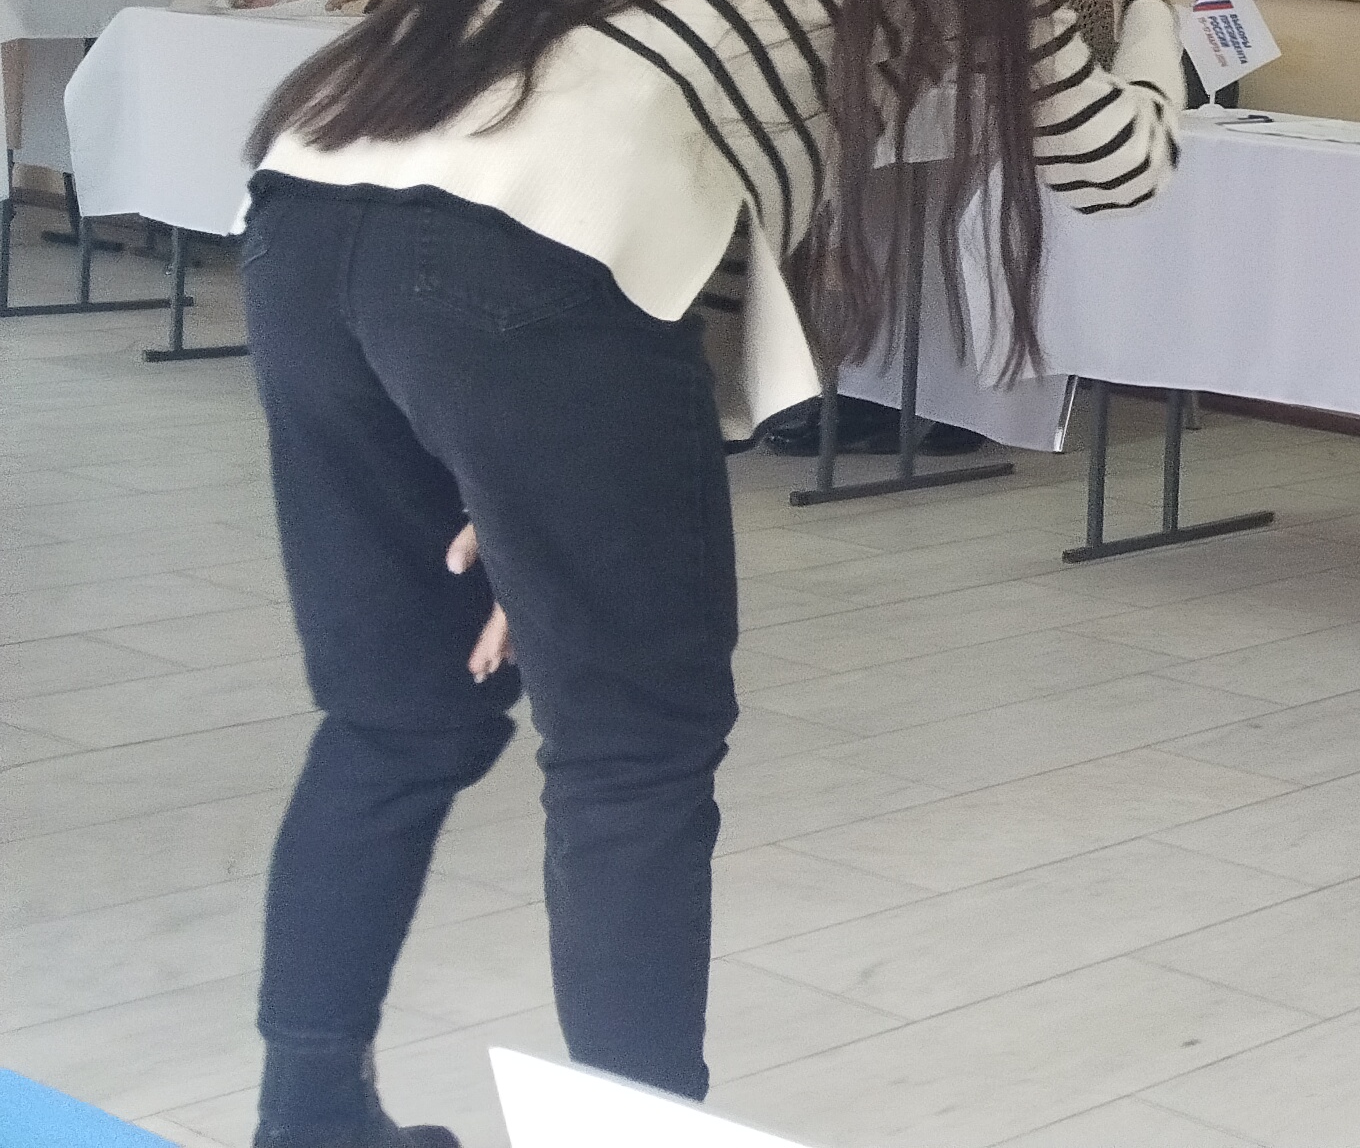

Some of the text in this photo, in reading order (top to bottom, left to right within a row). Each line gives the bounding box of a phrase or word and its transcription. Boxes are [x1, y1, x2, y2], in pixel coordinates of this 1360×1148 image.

[1207, 15, 1231, 48] РОССИИ
[1218, 14, 1249, 65] ПРЕЗИДЕНТА
[1229, 13, 1252, 49] ВЫБОРЫ
